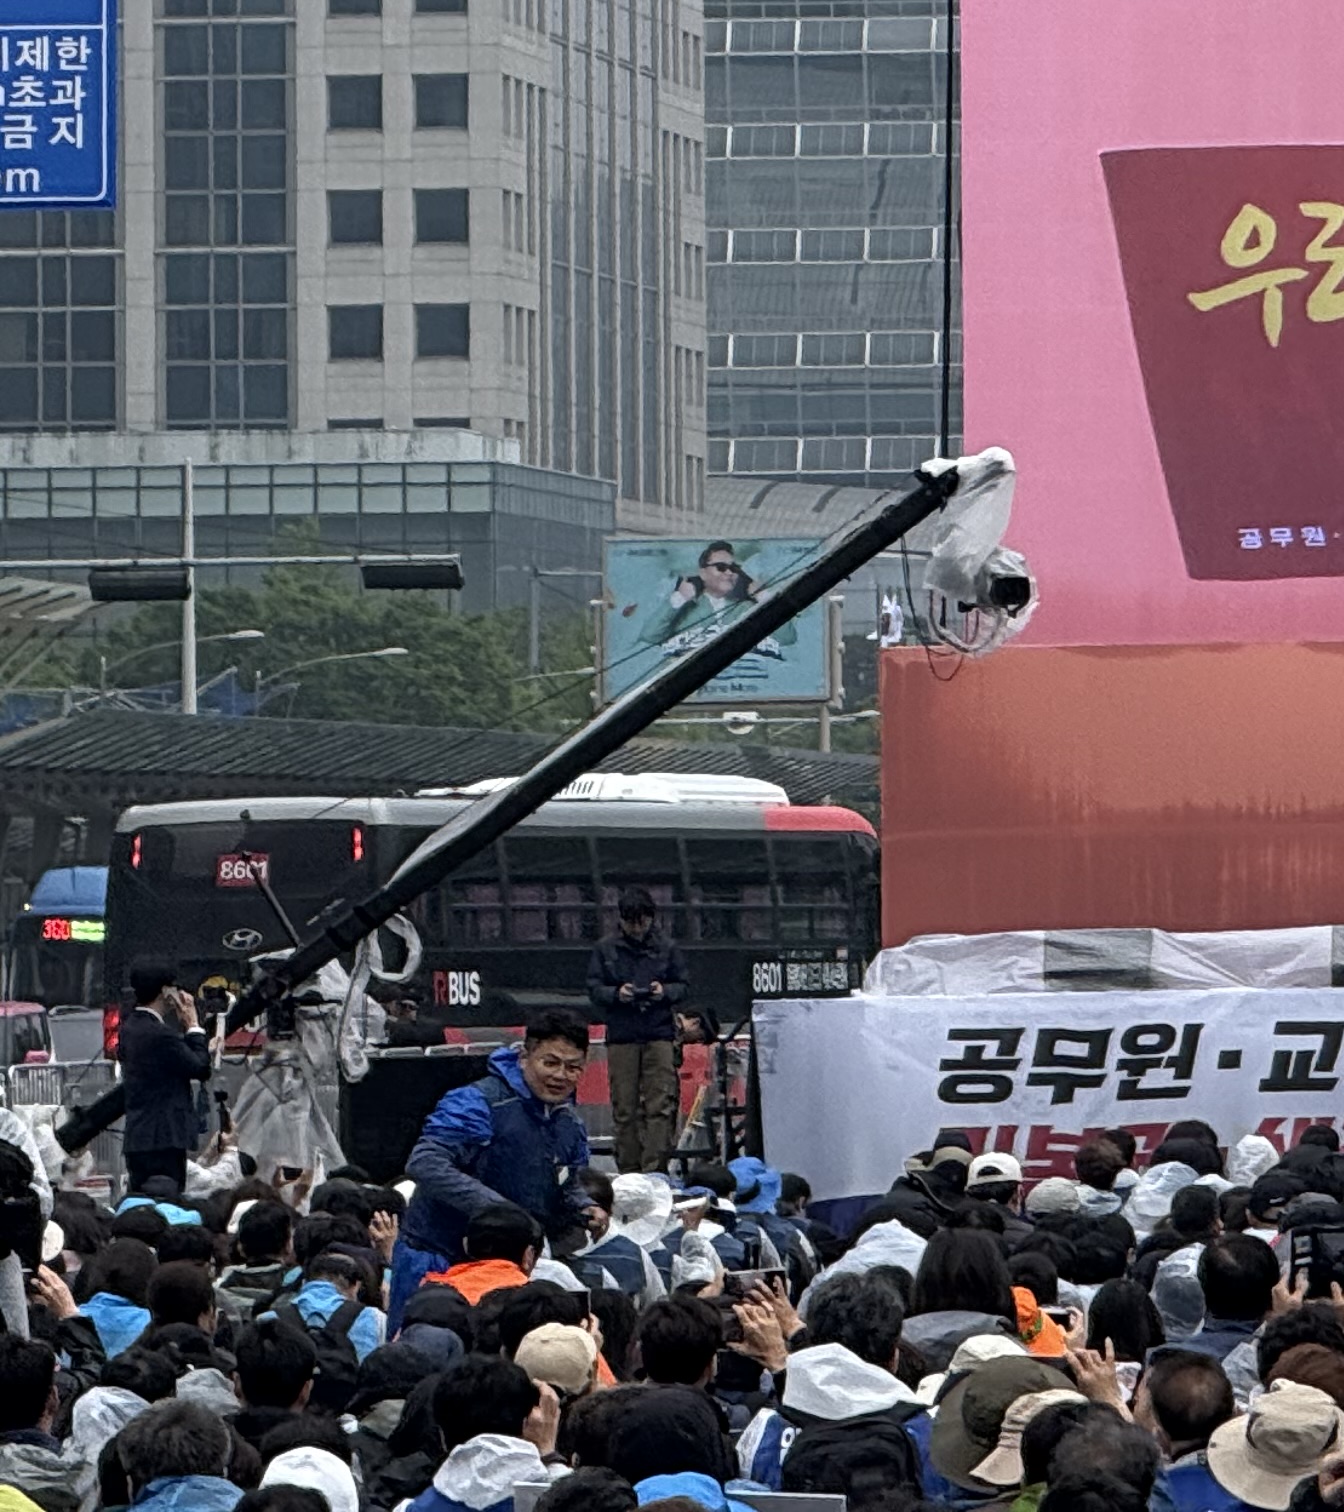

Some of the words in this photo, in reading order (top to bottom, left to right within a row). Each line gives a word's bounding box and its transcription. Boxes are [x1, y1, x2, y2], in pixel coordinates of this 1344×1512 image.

[0, 166, 41, 193] m
[219, 860, 268, 881] 8601
[753, 962, 782, 993] 8601
